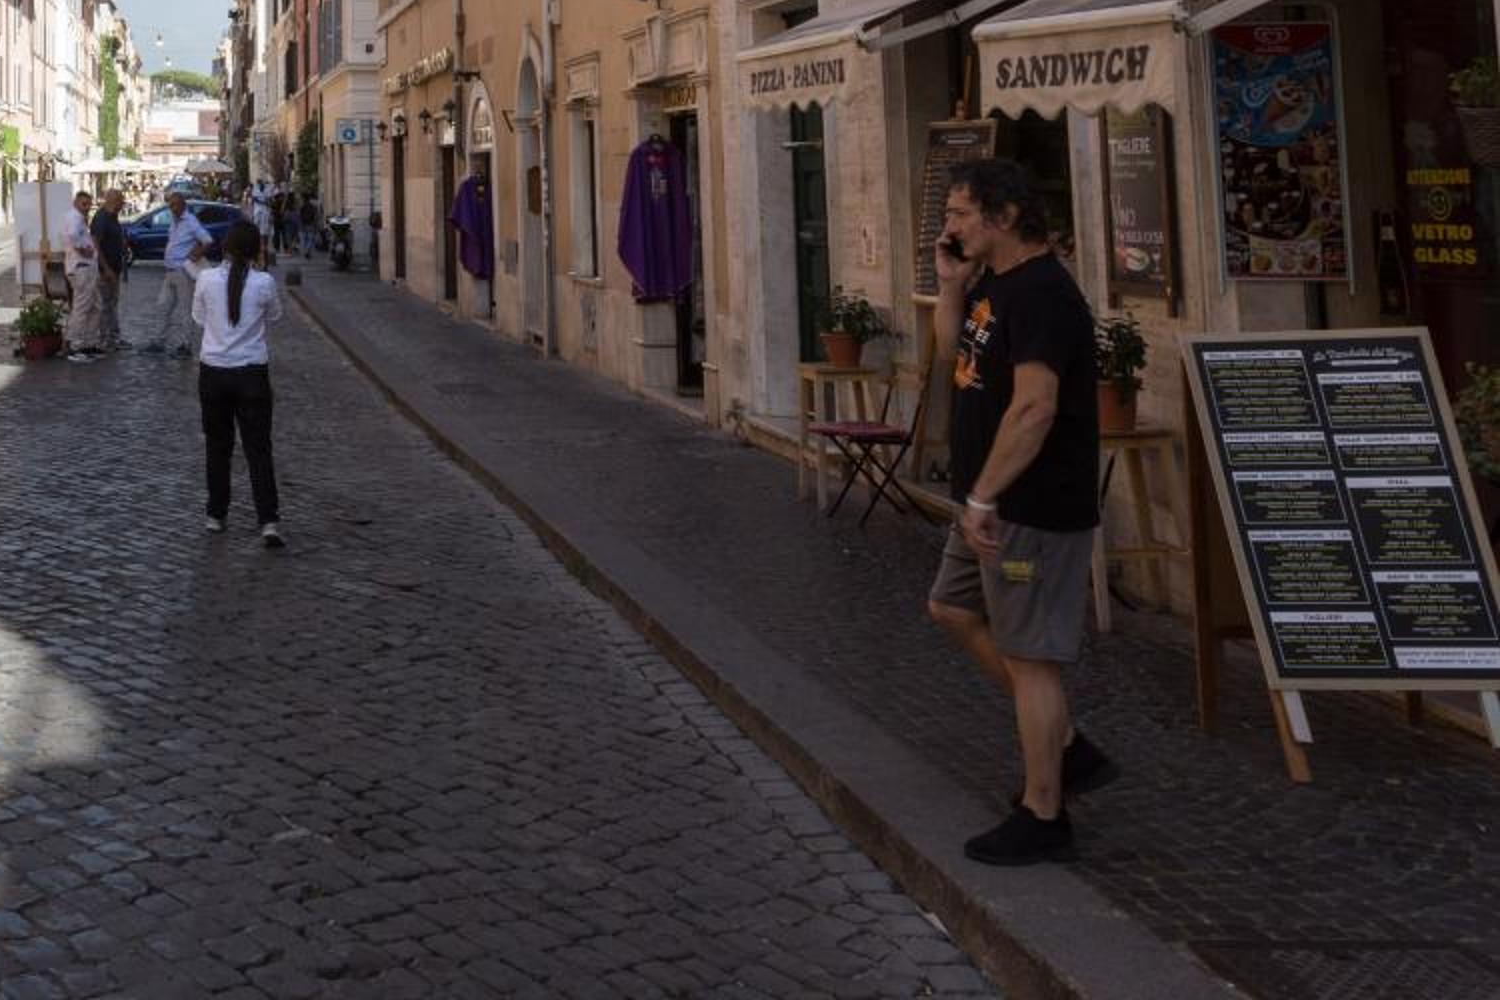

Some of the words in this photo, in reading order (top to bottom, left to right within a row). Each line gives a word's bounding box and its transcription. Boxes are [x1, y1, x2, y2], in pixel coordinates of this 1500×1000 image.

[750, 69, 785, 94] PIZZA
[793, 58, 845, 88] PANINI
[996, 43, 1151, 91] SANDWICH
[1412, 223, 1474, 241] VETRO
[1414, 247, 1477, 265] GLASS
